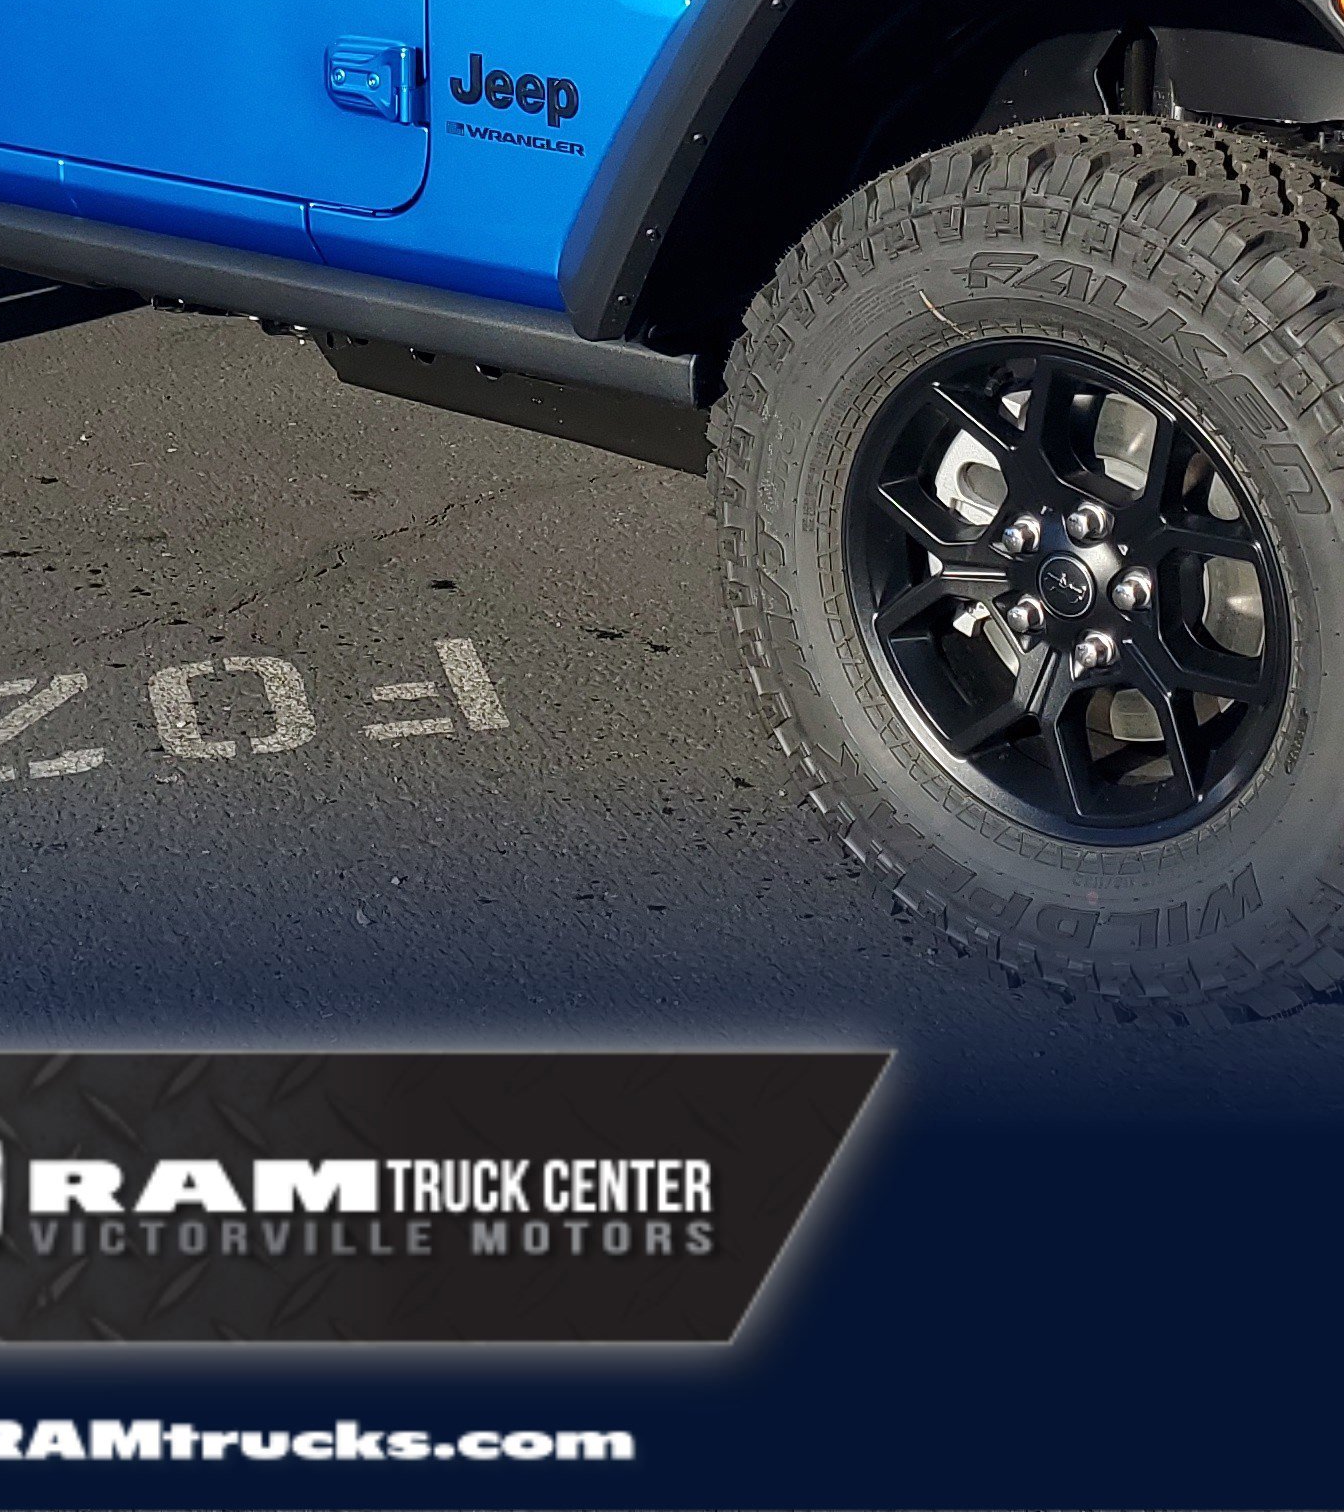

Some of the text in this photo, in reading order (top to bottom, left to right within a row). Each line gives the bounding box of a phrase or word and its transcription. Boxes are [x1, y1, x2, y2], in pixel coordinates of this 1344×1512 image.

[449, 52, 580, 128] Jeep
[465, 124, 586, 157] WRANGLER
[951, 251, 1332, 515] FALKEN
